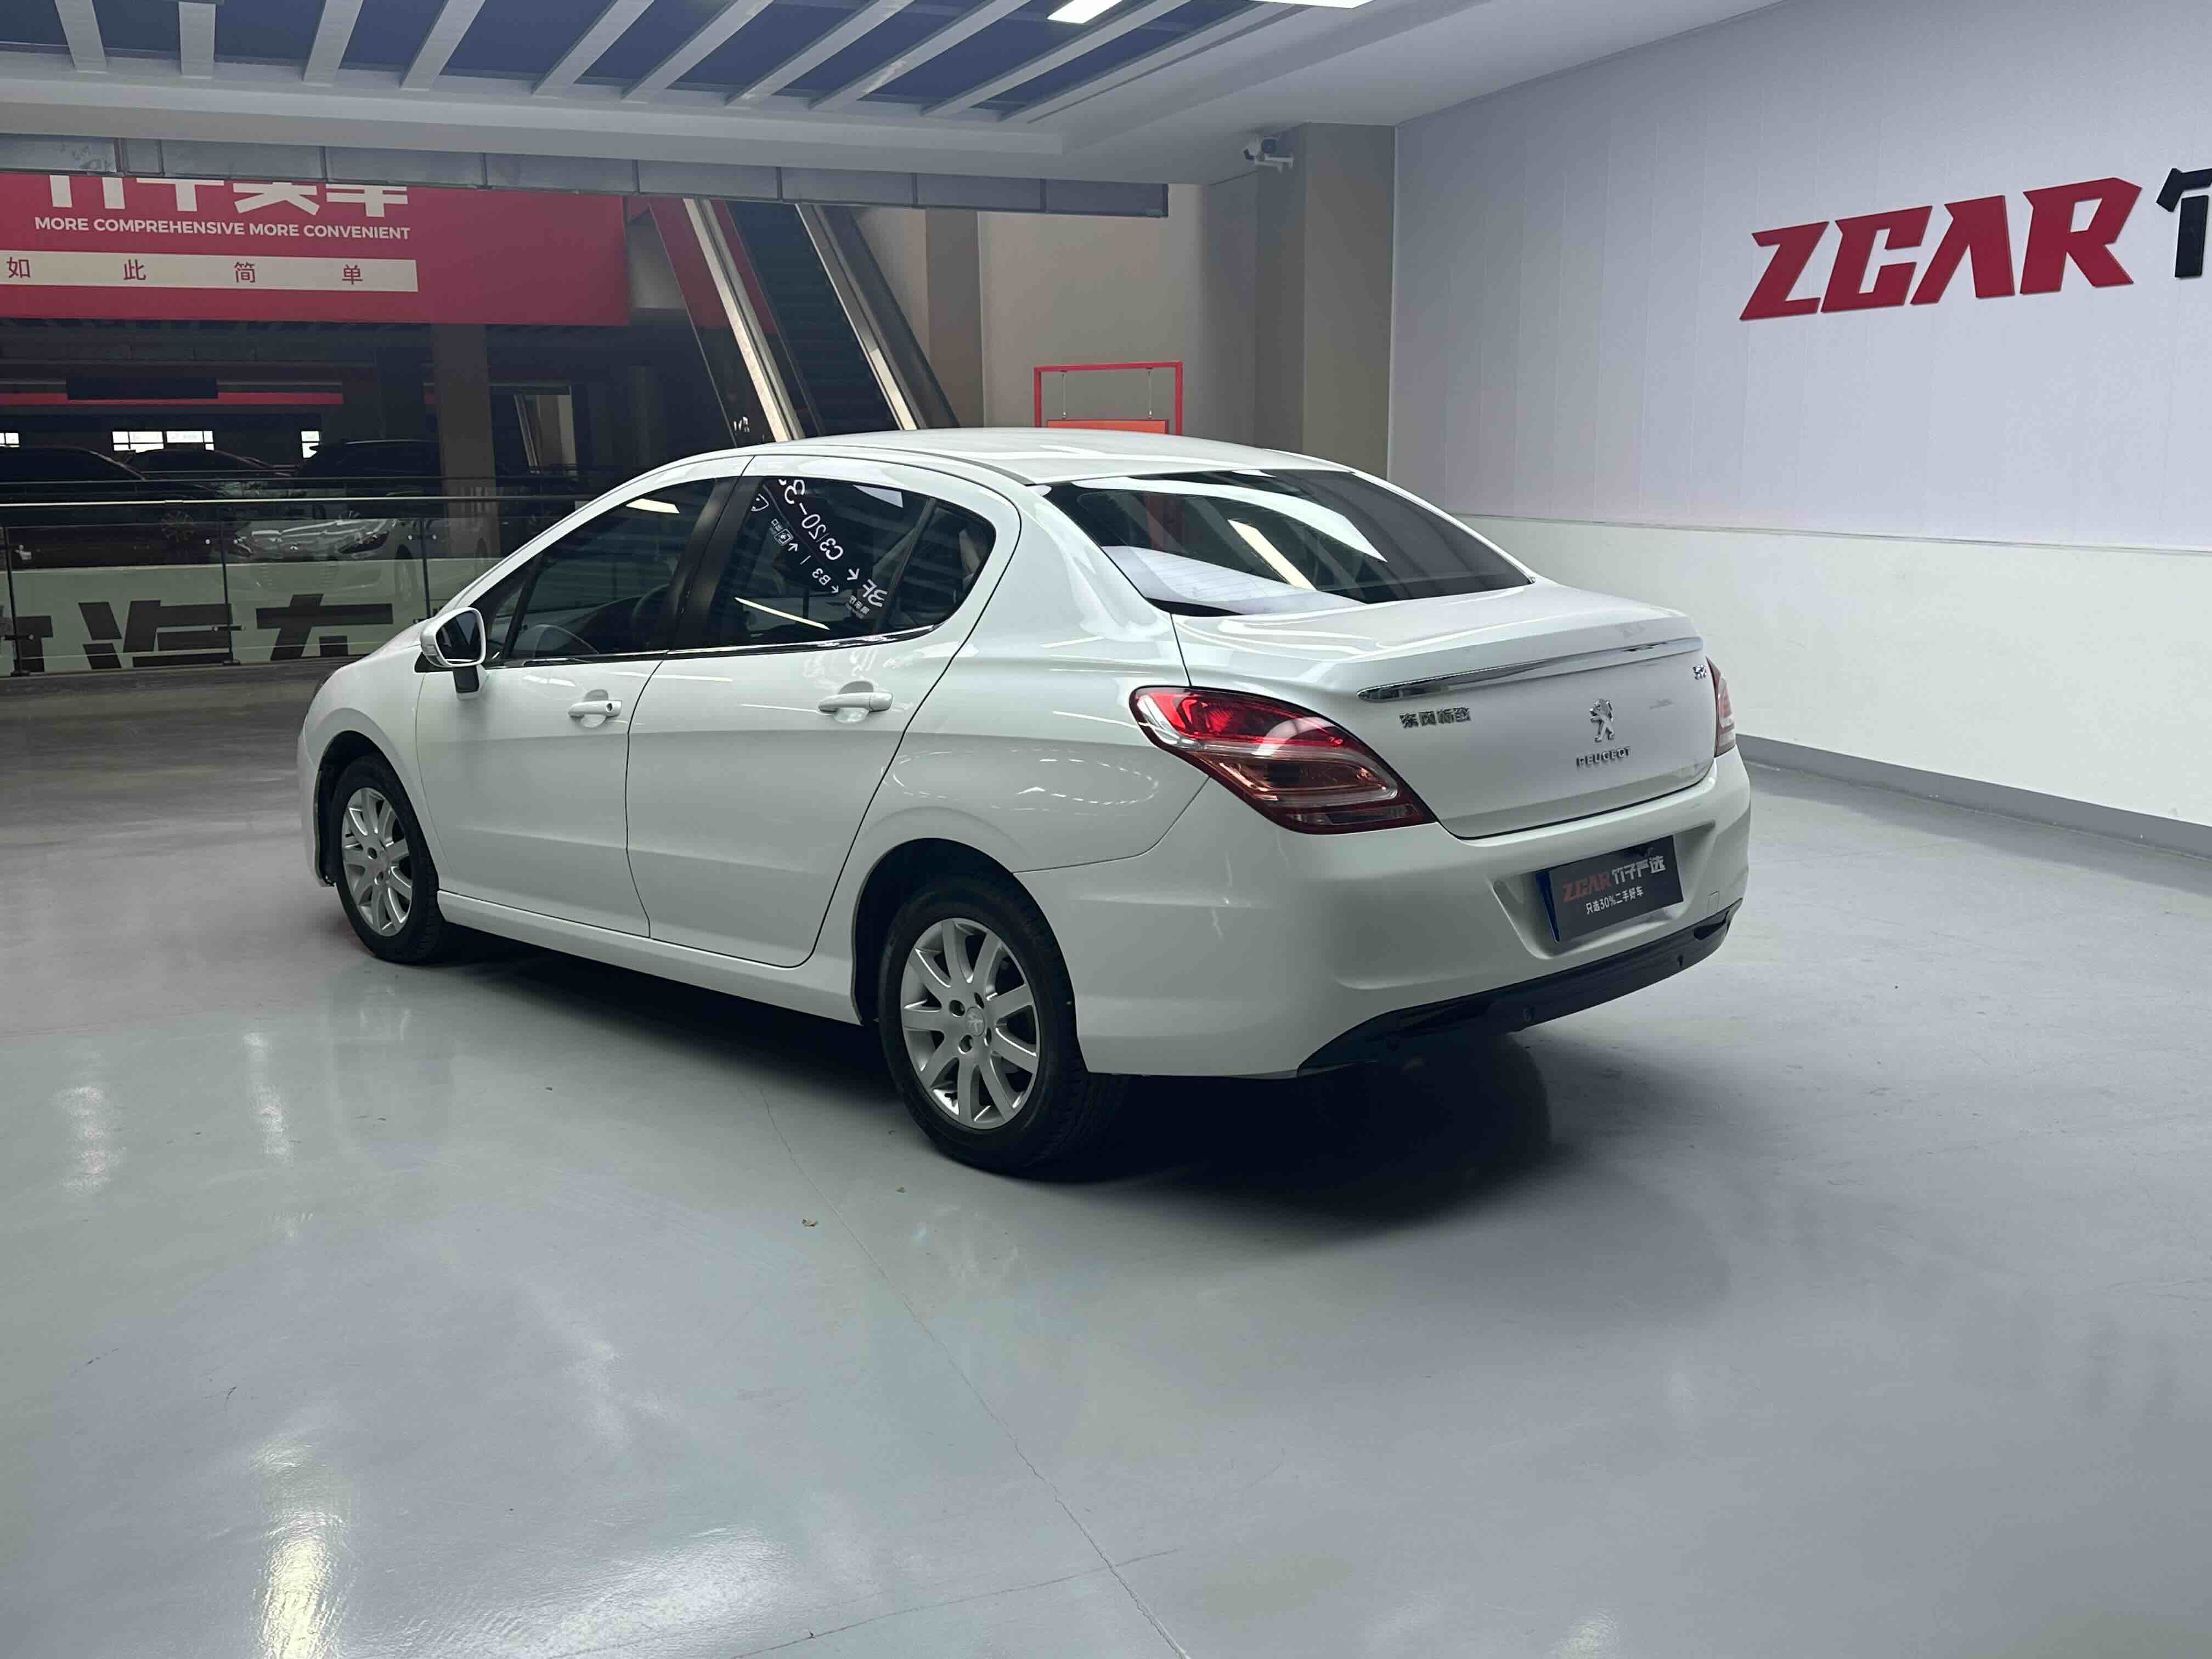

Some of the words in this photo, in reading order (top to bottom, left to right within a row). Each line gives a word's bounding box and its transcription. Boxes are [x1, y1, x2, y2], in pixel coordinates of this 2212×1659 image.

[35, 217, 89, 231] MORE
[93, 219, 245, 235] COMPREHENSIVE
[250, 223, 300, 237] MORE
[303, 224, 410, 240] CONVENIENT
[1739, 177, 2142, 321] ZCAR
[1576, 746, 1633, 768] PEUGEOT
